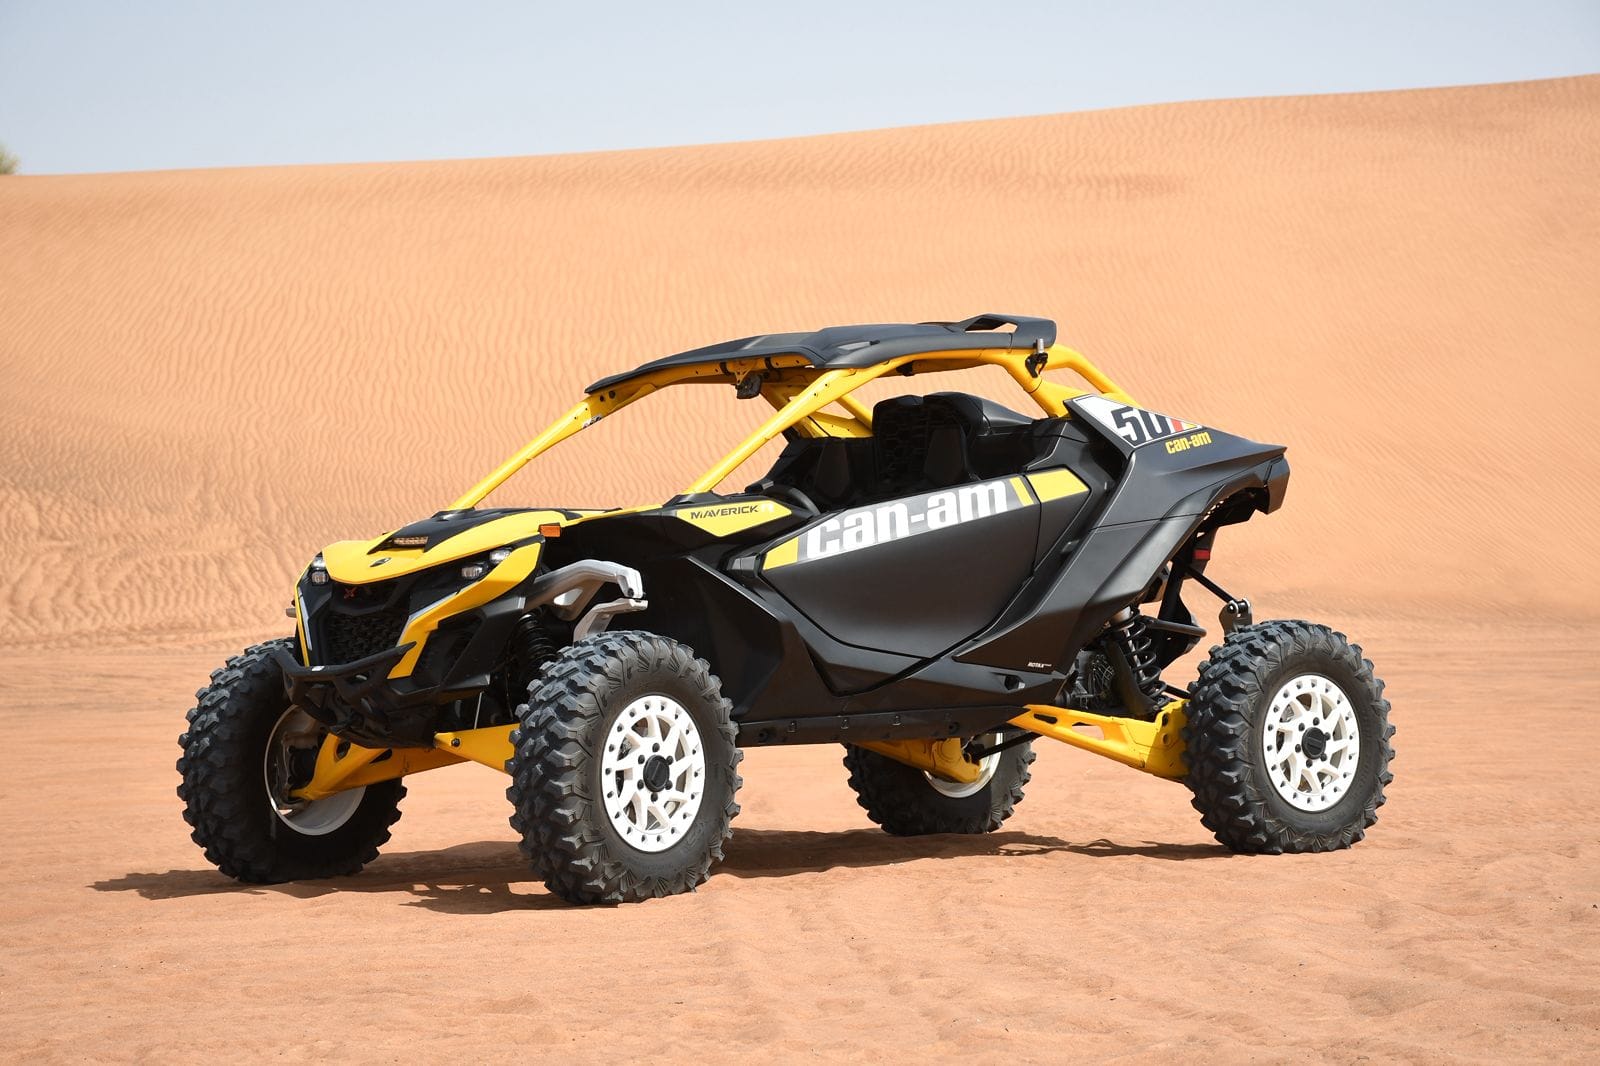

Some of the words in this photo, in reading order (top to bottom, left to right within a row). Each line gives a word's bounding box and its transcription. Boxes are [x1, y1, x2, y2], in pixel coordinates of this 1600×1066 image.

[1165, 431, 1212, 454] can-am
[690, 504, 759, 520] MAVERICK
[807, 480, 1008, 559] can-am
